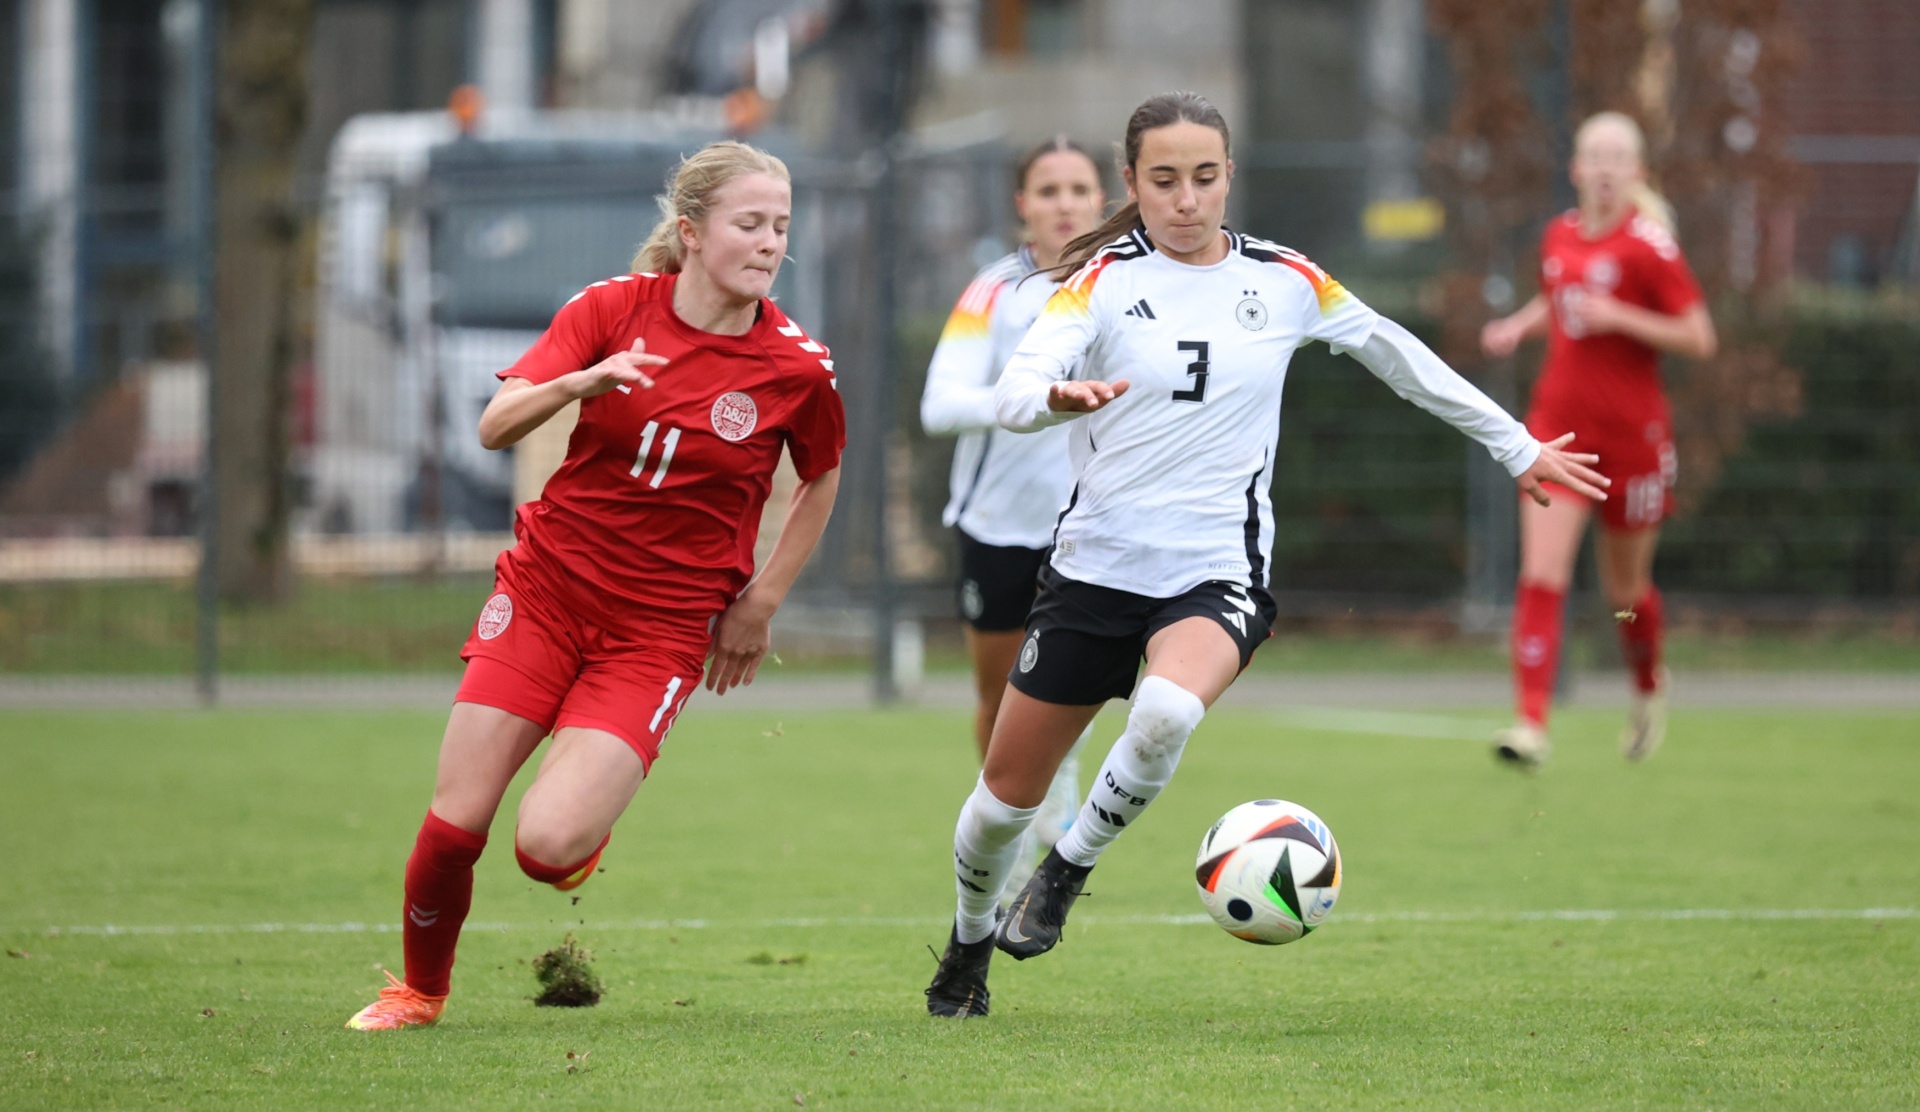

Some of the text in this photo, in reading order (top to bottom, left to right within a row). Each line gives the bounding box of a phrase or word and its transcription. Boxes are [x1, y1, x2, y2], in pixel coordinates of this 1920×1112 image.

[1172, 341, 1209, 404] 3
[722, 405, 747, 426] DBU
[629, 420, 682, 489] 11
[649, 676, 688, 748] 1
[1105, 771, 1147, 806] DFB
